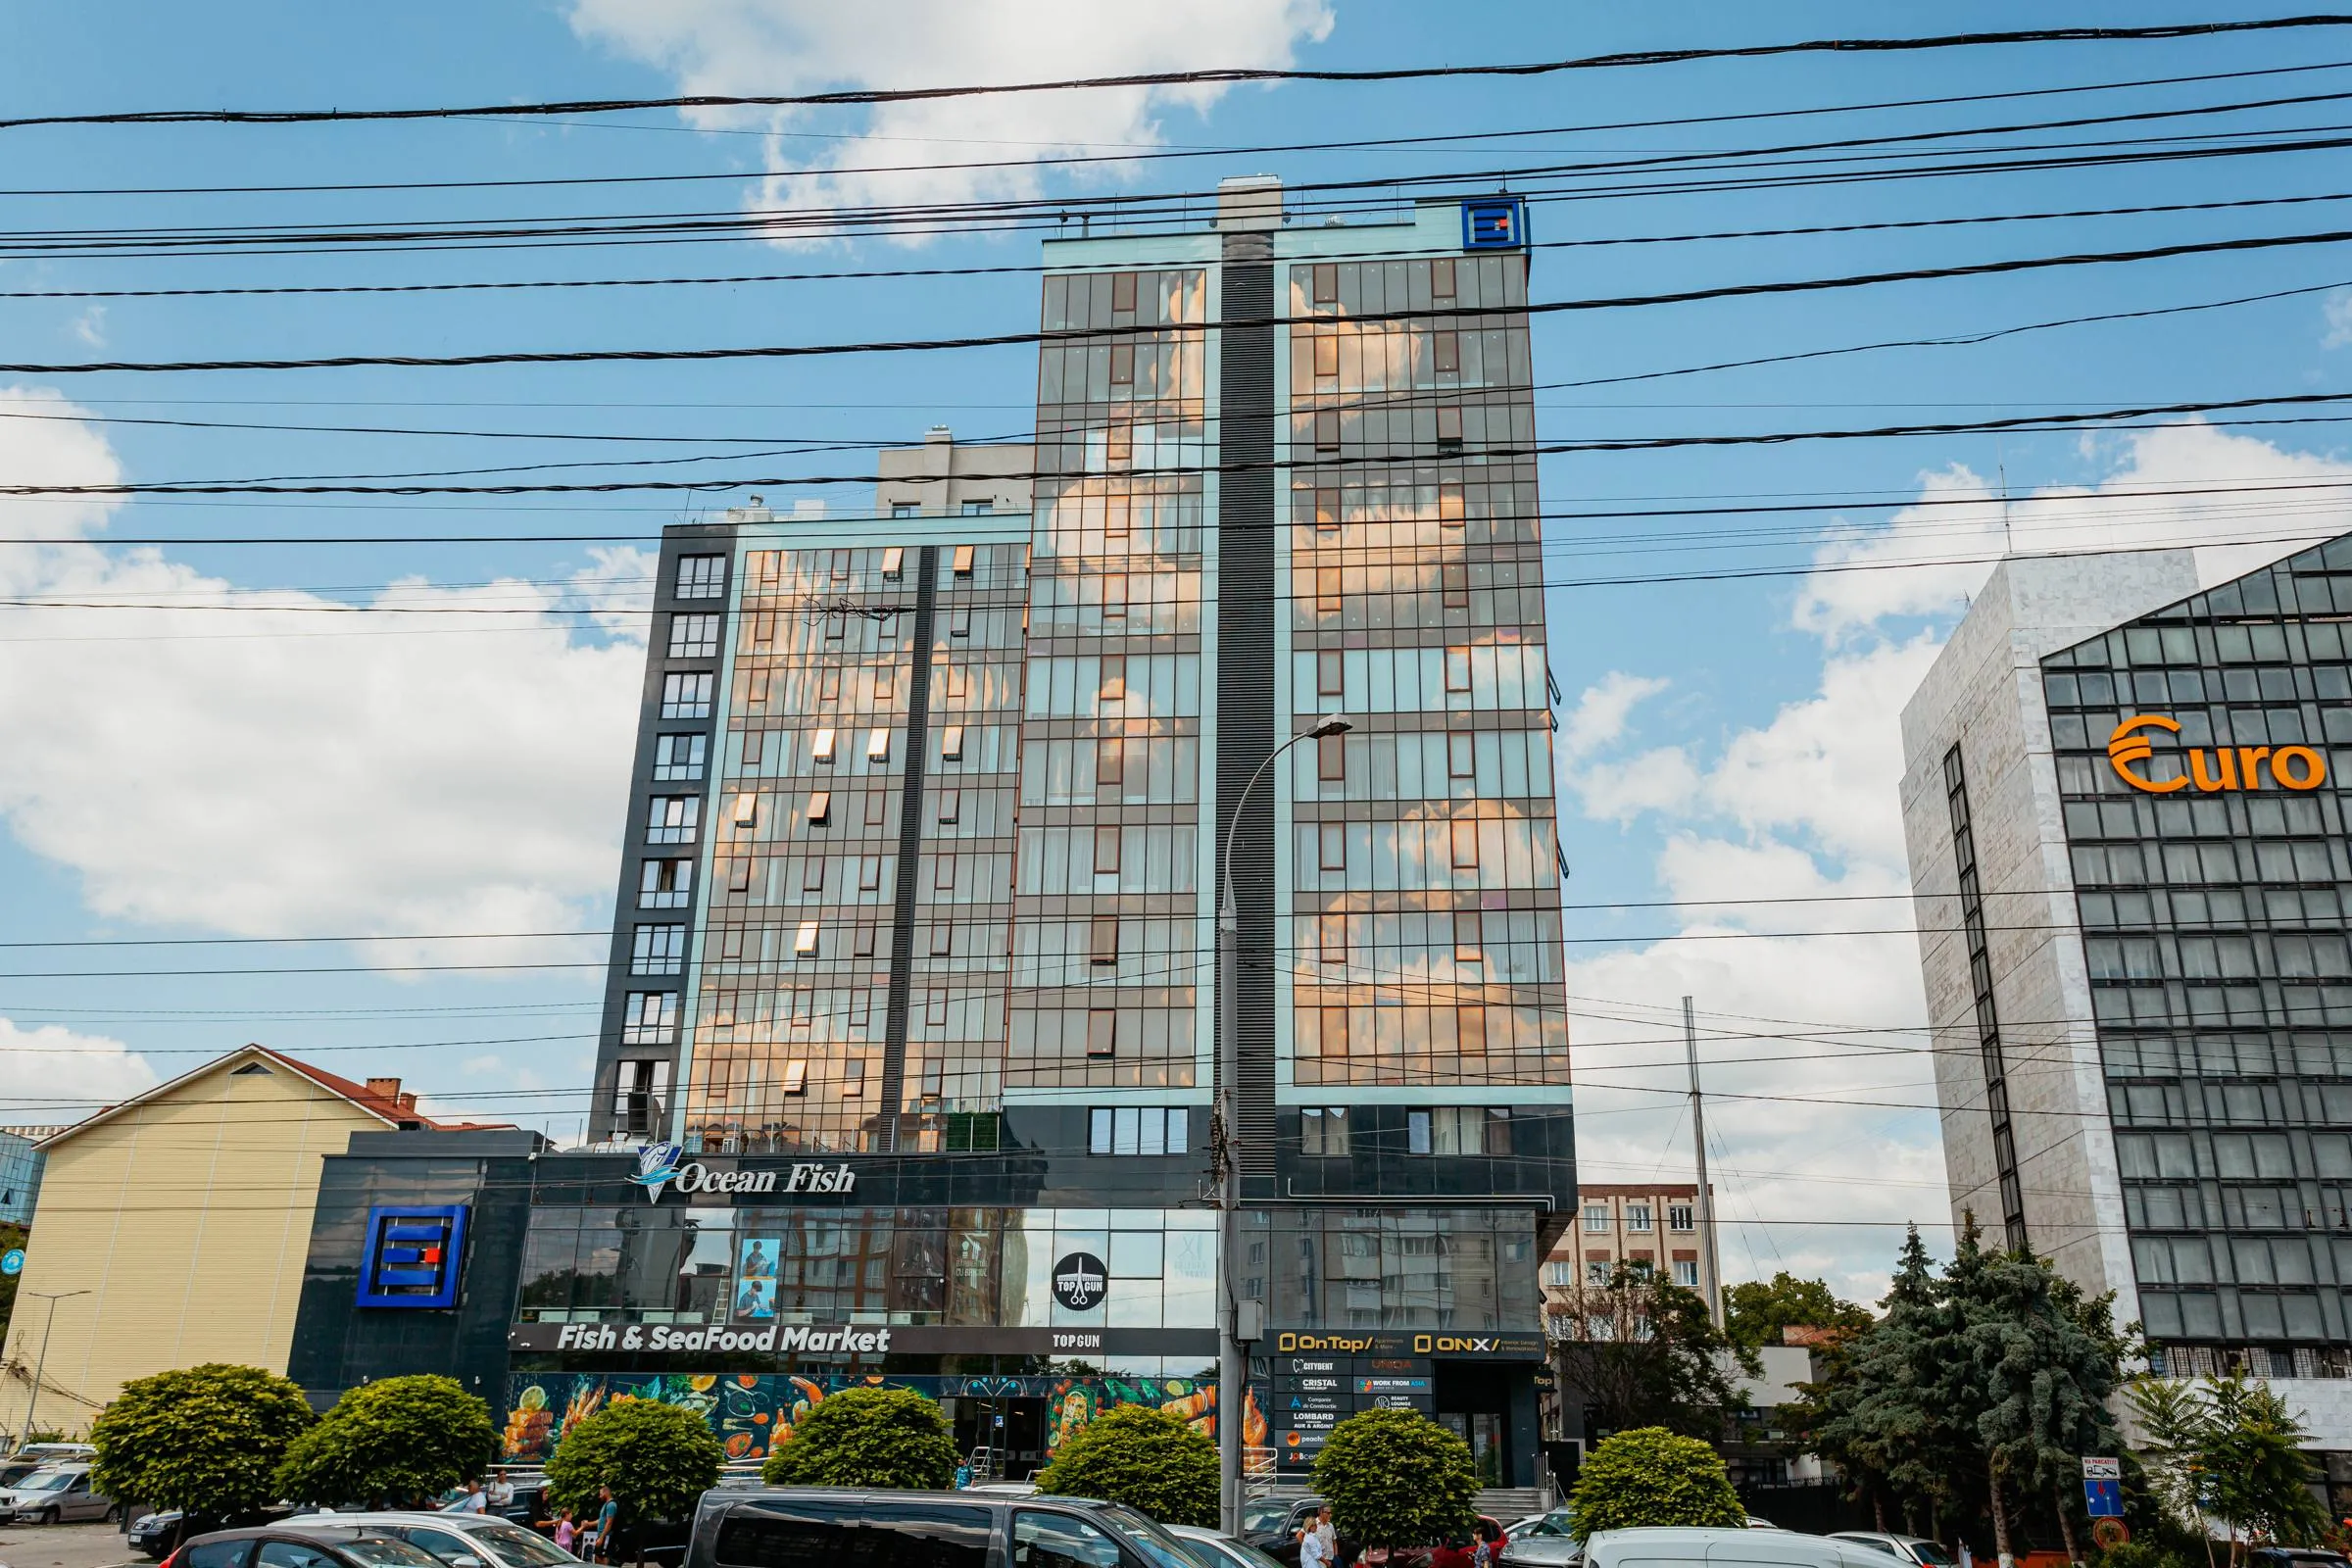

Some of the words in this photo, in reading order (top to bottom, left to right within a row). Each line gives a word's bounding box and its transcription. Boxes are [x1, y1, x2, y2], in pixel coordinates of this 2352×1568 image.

[675, 1162, 777, 1194] Ocean
[782, 1163, 856, 1194] Fish
[1057, 1281, 1075, 1292] TOP
[1084, 1281, 1103, 1292] GUN
[557, 1324, 616, 1350] Fish
[621, 1325, 643, 1350] &
[648, 1325, 776, 1351] SeaFood
[780, 1325, 891, 1352] Market
